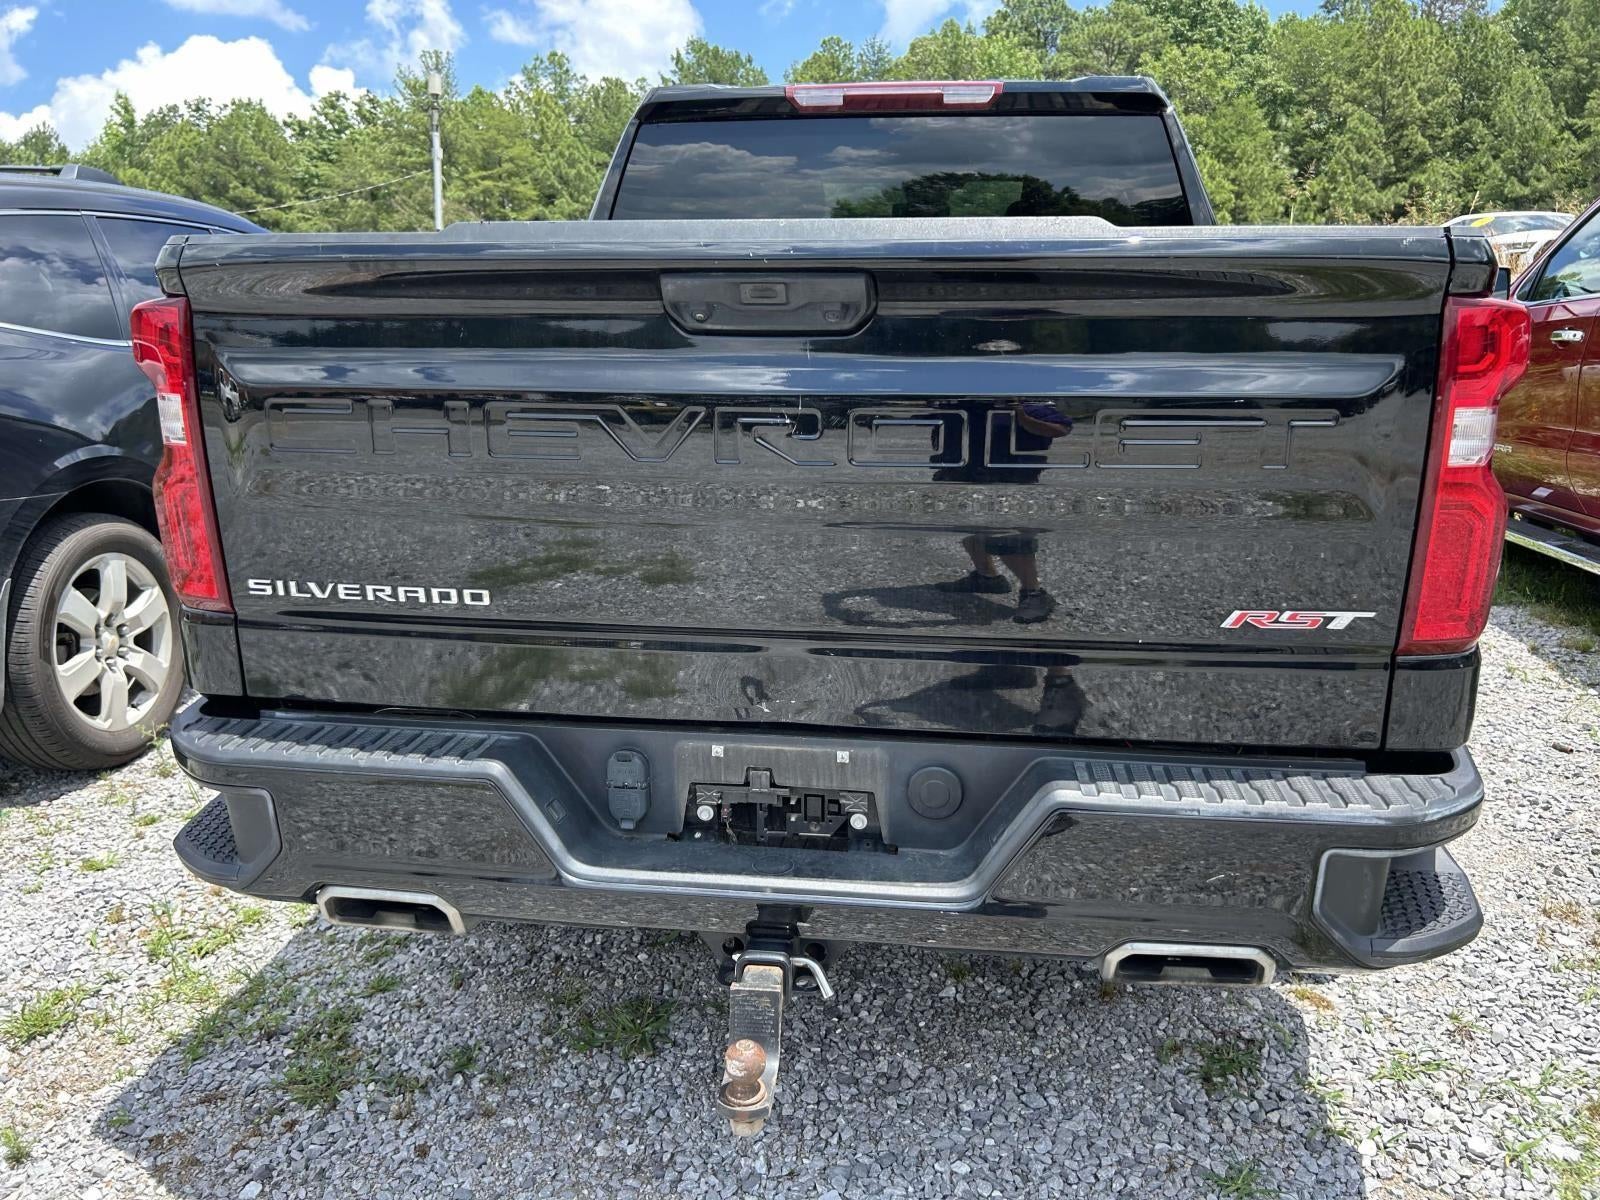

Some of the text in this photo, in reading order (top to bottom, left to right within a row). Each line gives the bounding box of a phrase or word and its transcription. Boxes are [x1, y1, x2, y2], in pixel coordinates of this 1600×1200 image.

[264, 397, 1340, 470] CHEVROLET
[247, 578, 491, 606] SILVERADO
[1220, 609, 1377, 630] RST
